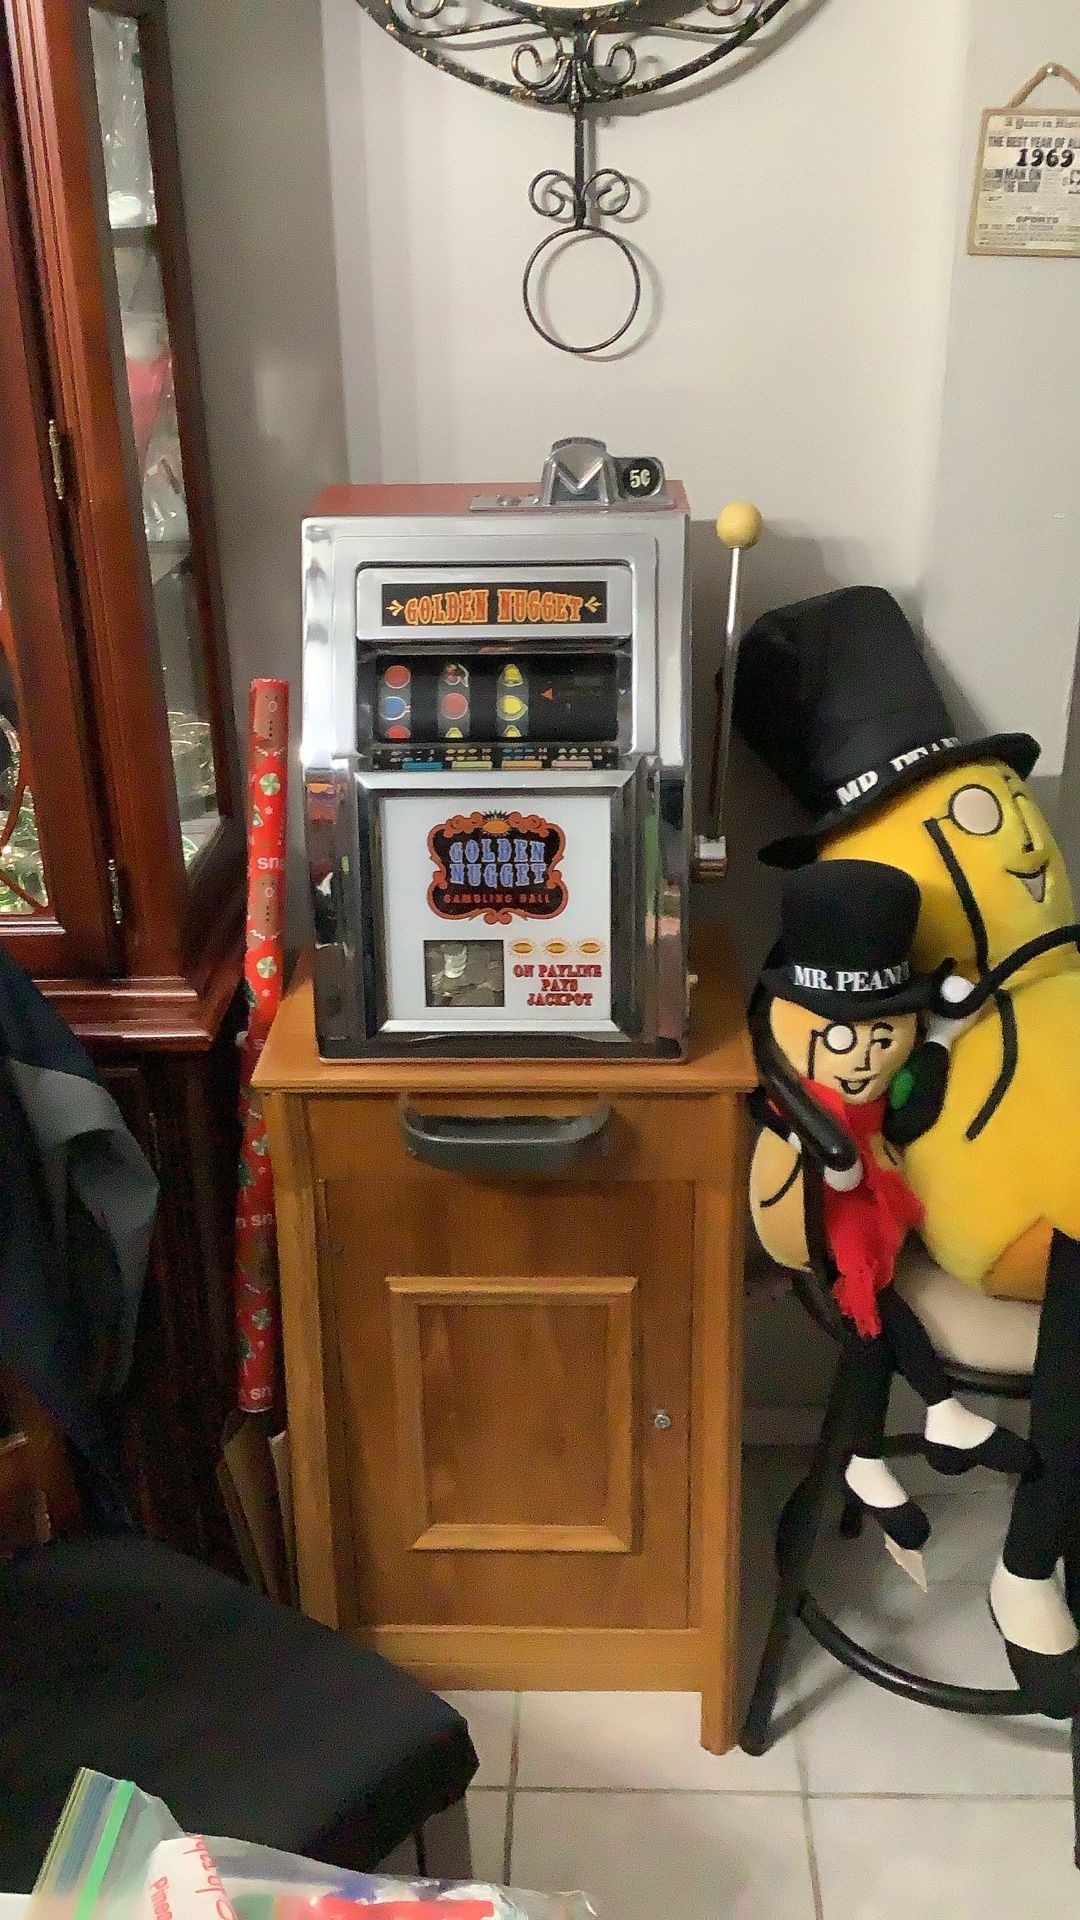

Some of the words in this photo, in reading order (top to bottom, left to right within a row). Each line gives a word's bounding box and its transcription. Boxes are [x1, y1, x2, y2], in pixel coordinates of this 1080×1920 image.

[1006, 136, 1028, 148] BEST
[1016, 149, 1074, 167] 1969
[630, 469, 650, 488] 5¢
[405, 590, 489, 625] GOLDEN
[497, 589, 583, 623] NUGGET
[449, 838, 546, 863] GOLDEN
[449, 862, 547, 888] NUGGET
[513, 965, 534, 977] ON
[538, 965, 602, 977] PAYLINE
[541, 979, 578, 992] PAYS
[527, 993, 593, 1006] JACKPOT
